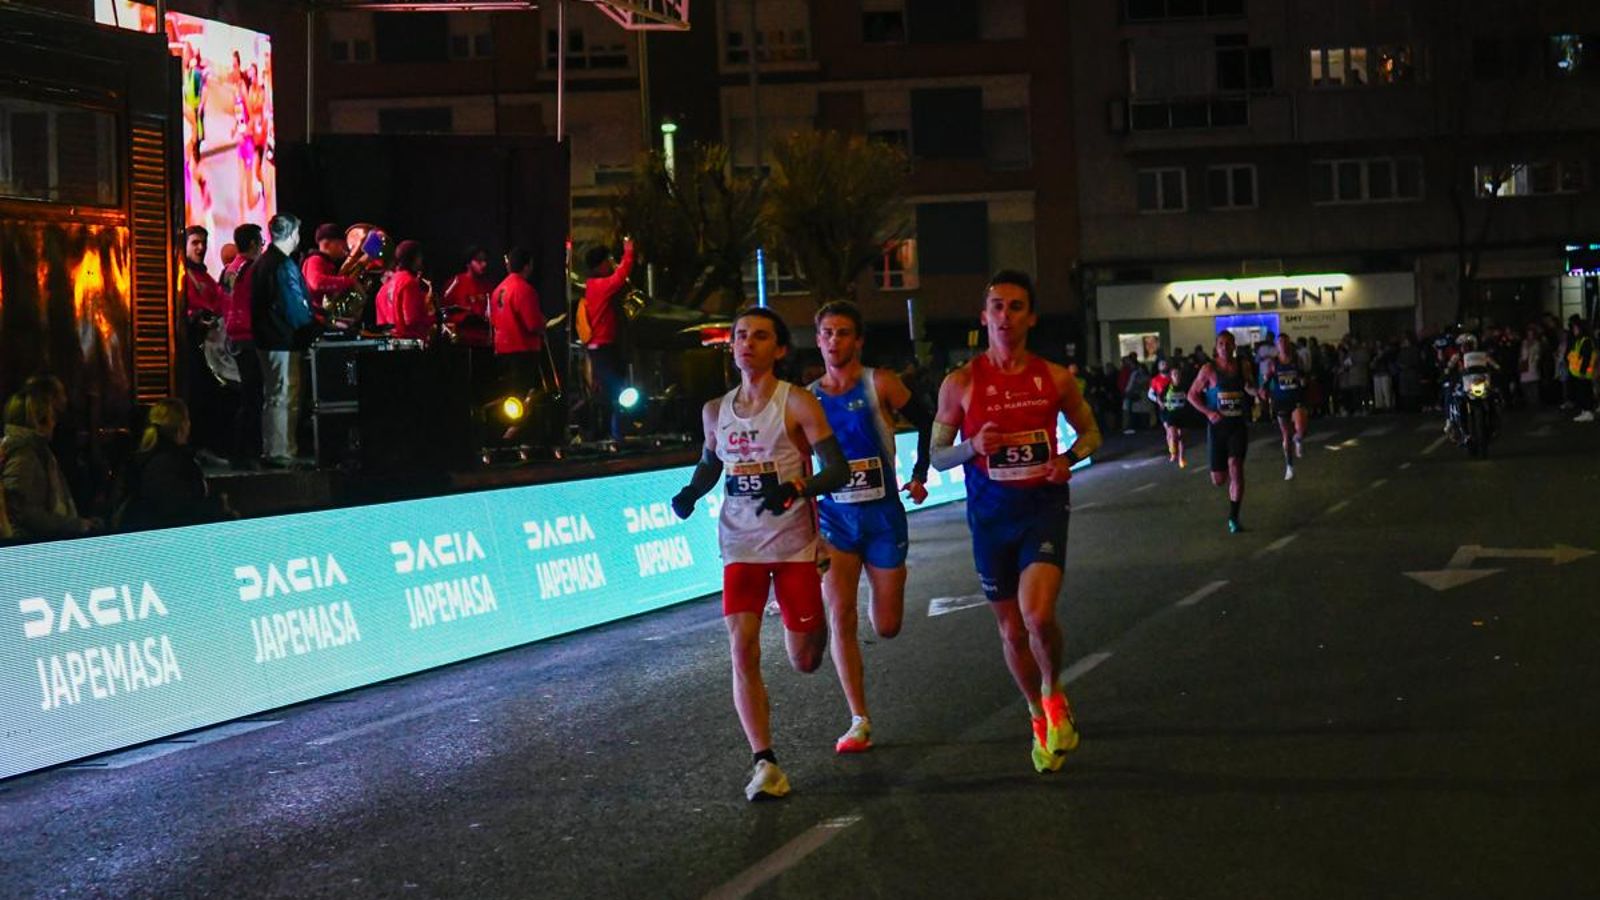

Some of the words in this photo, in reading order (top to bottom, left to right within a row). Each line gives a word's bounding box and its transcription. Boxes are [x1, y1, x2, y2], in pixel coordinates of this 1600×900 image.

[1168, 287, 1343, 311] VITALDENT
[1003, 398, 1049, 410] MARATHON
[728, 430, 759, 445] CAT
[1005, 445, 1034, 463] 53
[737, 475, 762, 492] 55
[390, 531, 486, 574] DACIA
[523, 513, 596, 550] DACIA
[234, 553, 348, 601] DACIA
[536, 552, 606, 599] JAPEMASA
[634, 536, 694, 577] JAPEMASA
[19, 581, 168, 639] DACIA
[405, 574, 498, 630] JAPEMASA
[251, 601, 361, 663] JAPEMASA
[37, 635, 182, 711] JAPEMASA
